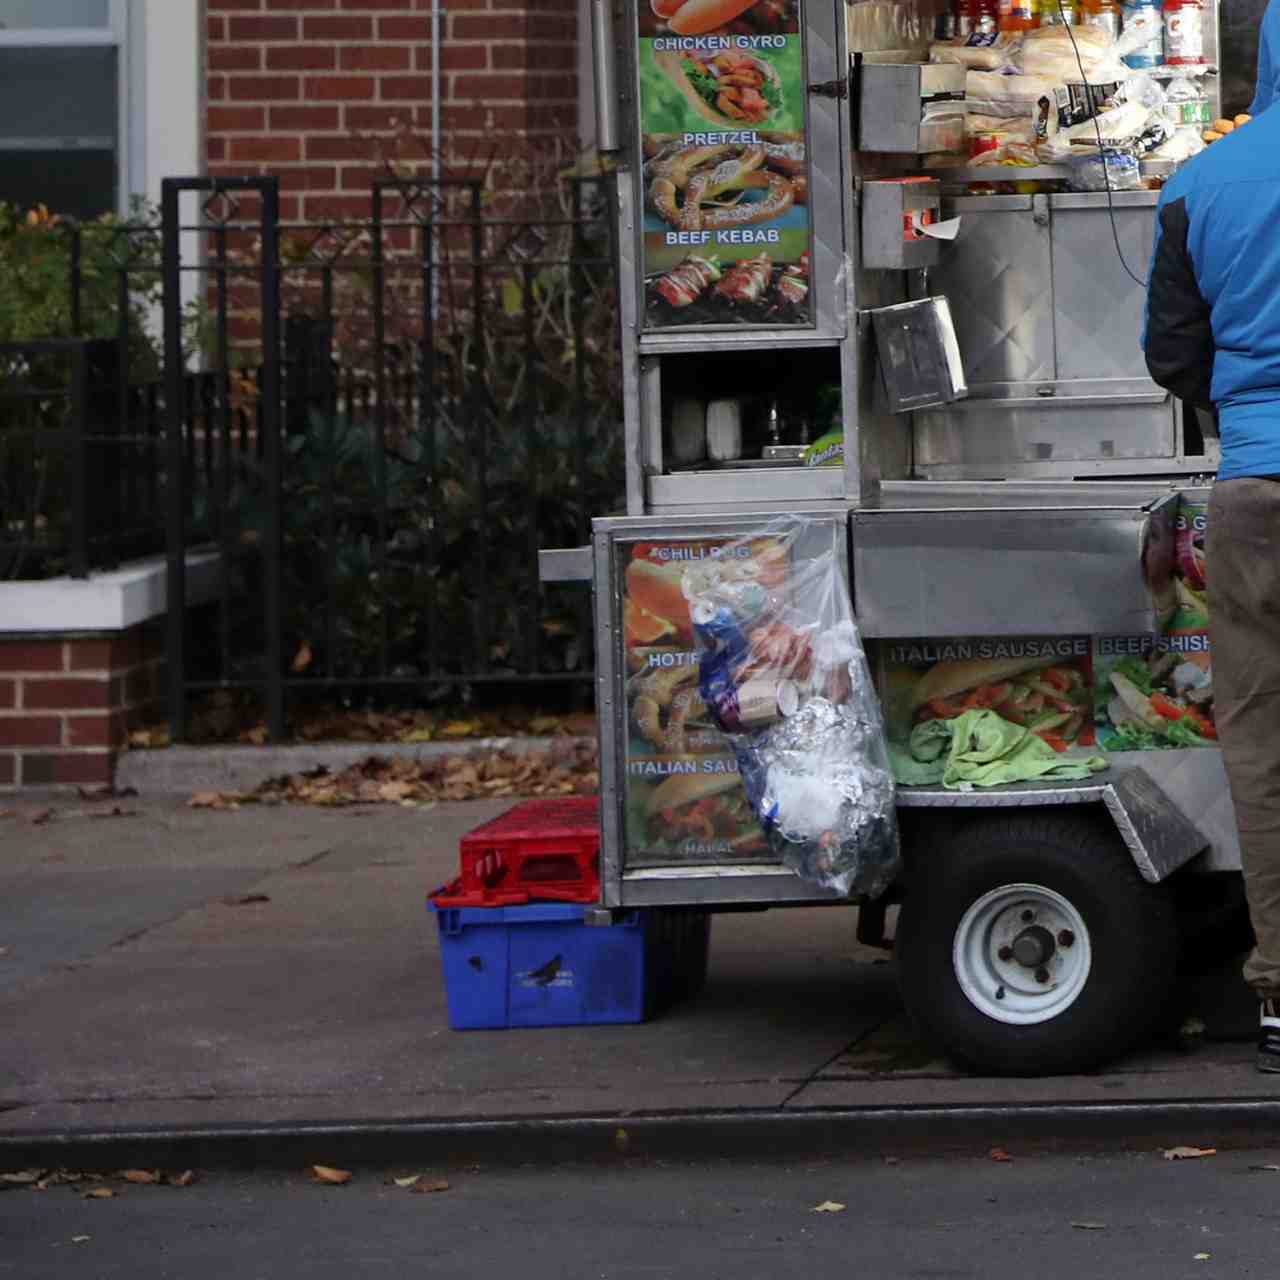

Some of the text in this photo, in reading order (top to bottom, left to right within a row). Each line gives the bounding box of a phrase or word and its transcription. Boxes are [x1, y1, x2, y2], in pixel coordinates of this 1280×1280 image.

[654, 35, 786, 51] CHICKEN GYRO
[683, 131, 762, 145] PRETZEL
[666, 229, 779, 245] BEEF KEBAB
[656, 547, 705, 561] CHILI
[892, 640, 1088, 663] ITALIAN SAUSAGE
[1103, 638, 1151, 655] BEEF
[649, 653, 687, 667] HOT
[632, 761, 697, 775] ITALIAN
